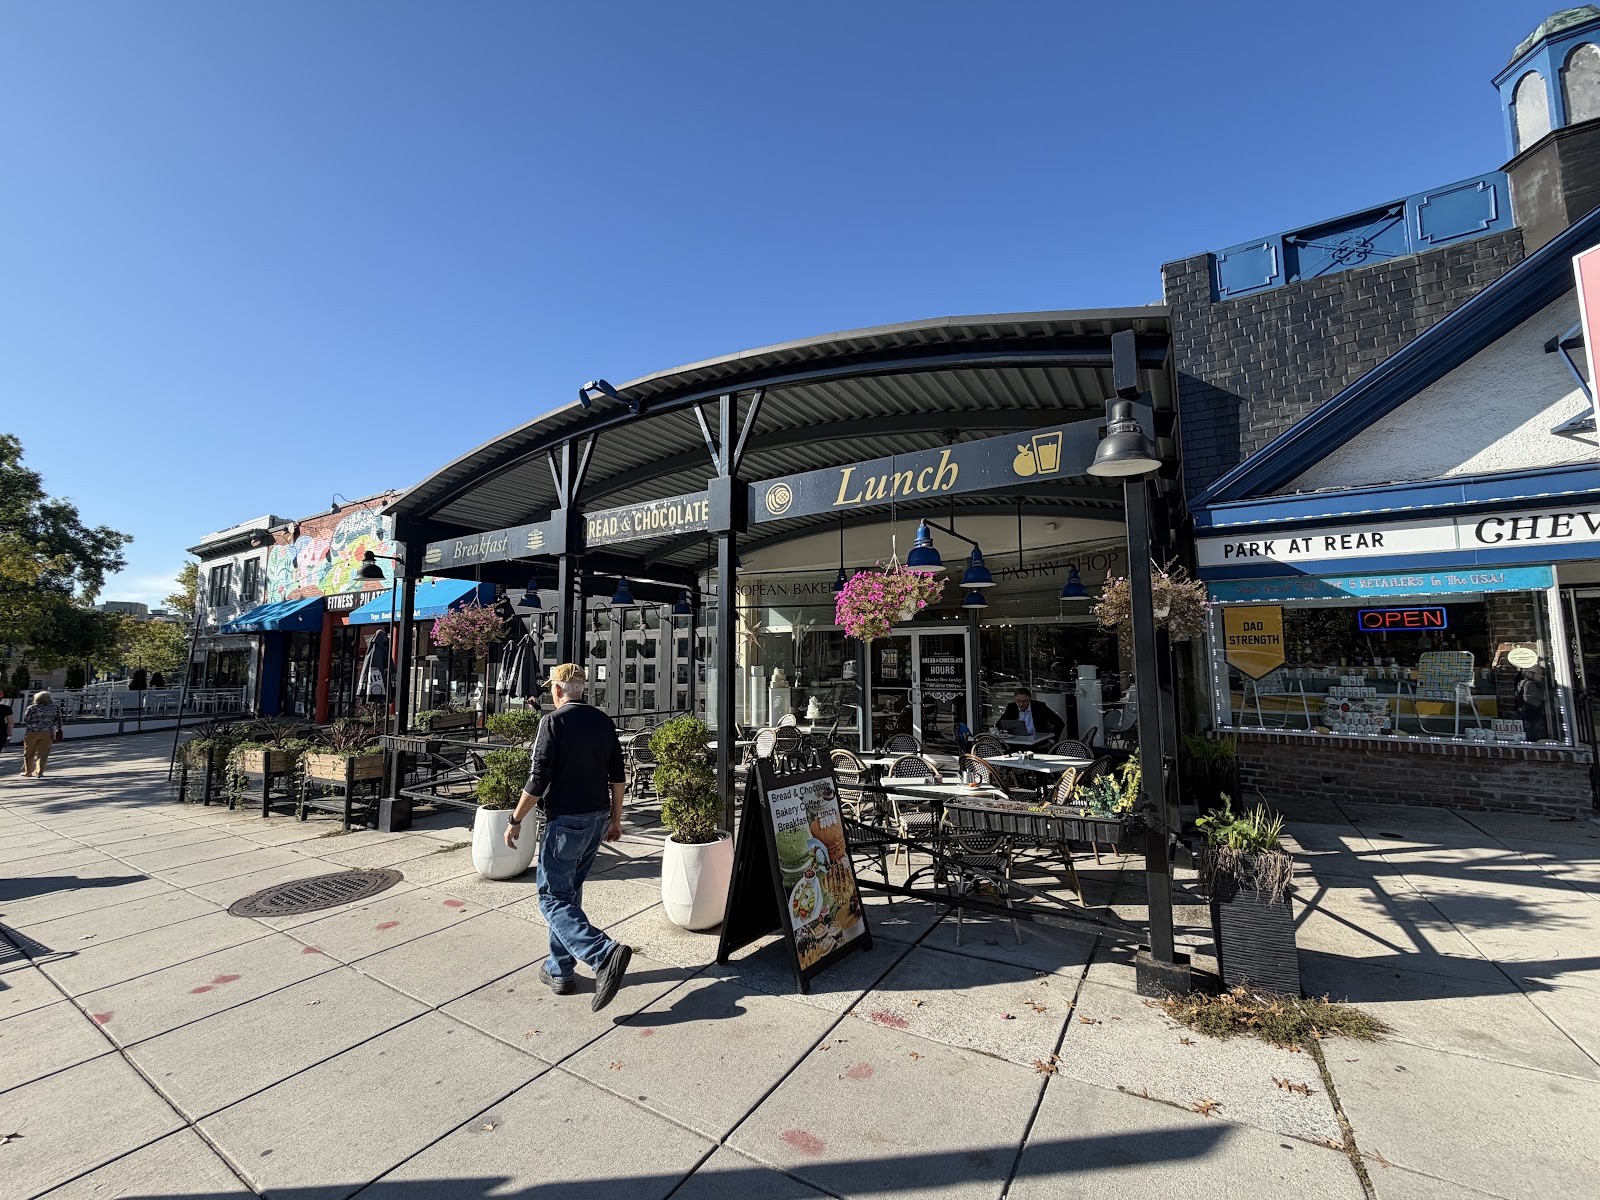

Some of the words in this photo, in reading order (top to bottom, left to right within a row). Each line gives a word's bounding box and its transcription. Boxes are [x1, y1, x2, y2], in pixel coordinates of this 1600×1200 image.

[833, 449, 959, 506] Lunch
[584, 516, 618, 539] READ
[621, 517, 631, 532] &
[634, 499, 709, 532] CHOCOLATE
[1475, 511, 1600, 544] CHEV
[453, 534, 509, 560] Breakfast
[1223, 540, 1276, 559] PARK
[1288, 537, 1313, 554] AT
[1324, 532, 1385, 551] REAR
[1002, 559, 1059, 581] PASTRY
[716, 583, 788, 597] ROPEAN
[793, 581, 836, 595] BAKER
[1348, 579, 1356, 589] 5
[1360, 577, 1424, 588] RETAILERS
[1430, 575, 1442, 586] In
[1445, 574, 1468, 585] The
[327, 593, 354, 610] FITNESS
[1243, 621, 1264, 632] DAD
[1363, 610, 1442, 628] OPEN
[1229, 635, 1280, 645] STRENGTH
[930, 665, 955, 675] HOURS
[771, 790, 792, 803] Bread
[793, 788, 799, 797] &
[800, 781, 831, 796] Chocolate
[775, 806, 799, 819] Bakery
[800, 800, 821, 811] Coffee
[777, 816, 809, 832] Breakfast
[817, 807, 837, 820] Lunch
